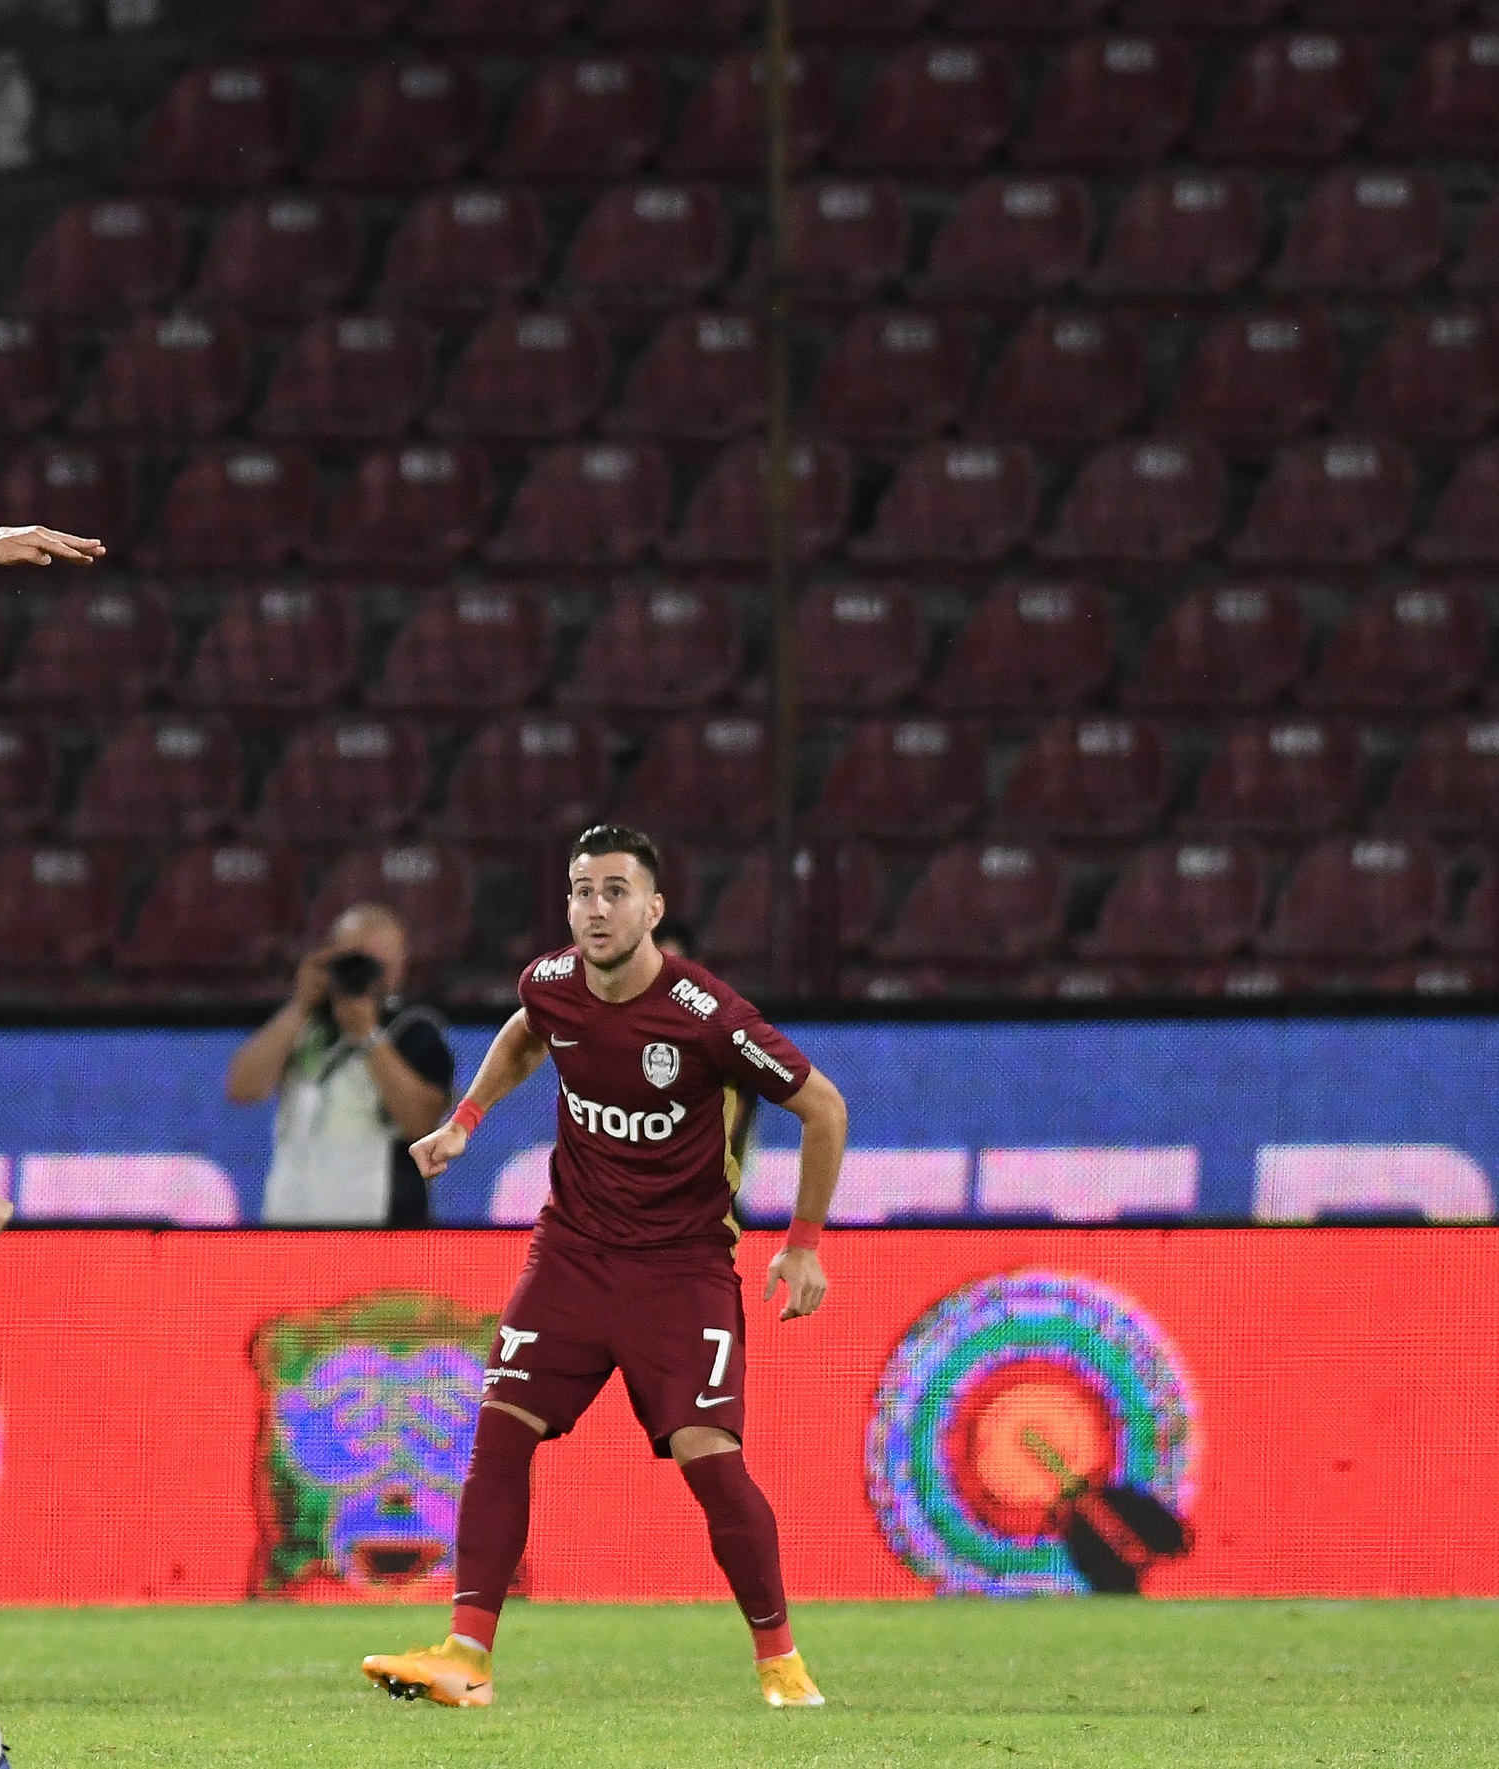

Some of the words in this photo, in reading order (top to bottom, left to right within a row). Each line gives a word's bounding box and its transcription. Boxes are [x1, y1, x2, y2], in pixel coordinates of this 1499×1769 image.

[532, 955, 576, 977] RMB
[671, 978, 718, 1016] RMB
[744, 1040, 794, 1083] POKERSTARS
[702, 1327, 734, 1388] 7
